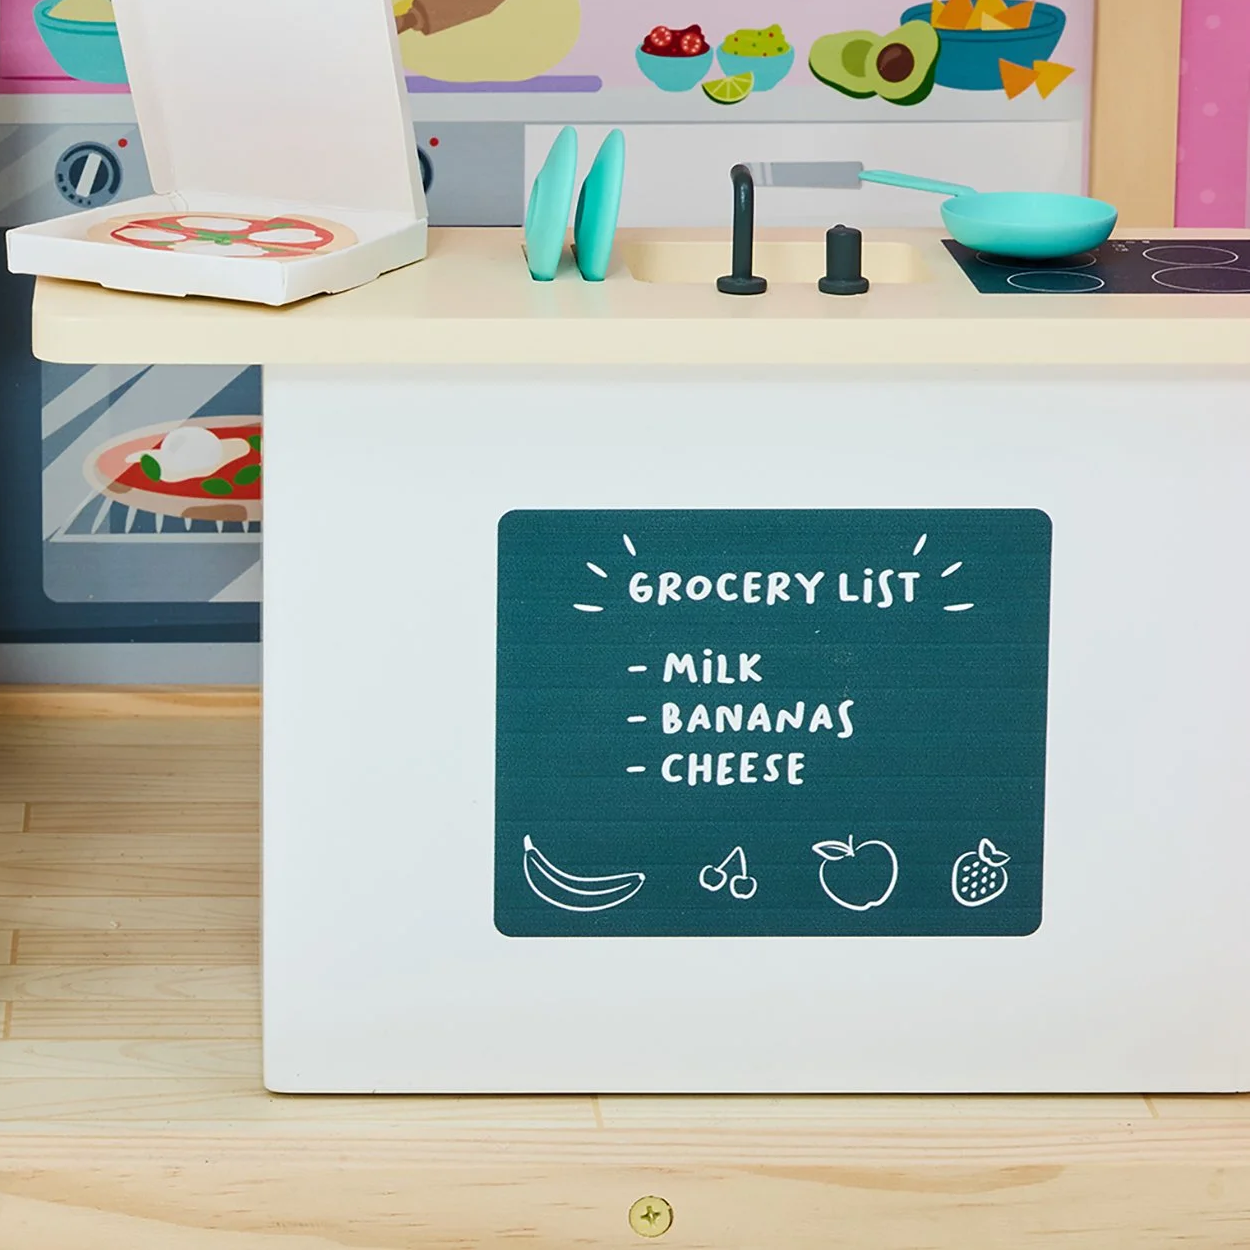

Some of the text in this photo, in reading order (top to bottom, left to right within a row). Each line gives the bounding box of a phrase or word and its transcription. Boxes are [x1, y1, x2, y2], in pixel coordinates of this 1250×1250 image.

[628, 571, 825, 606] GROCERY
[662, 699, 855, 739] BANANAS
[661, 752, 805, 787] CHEESE
